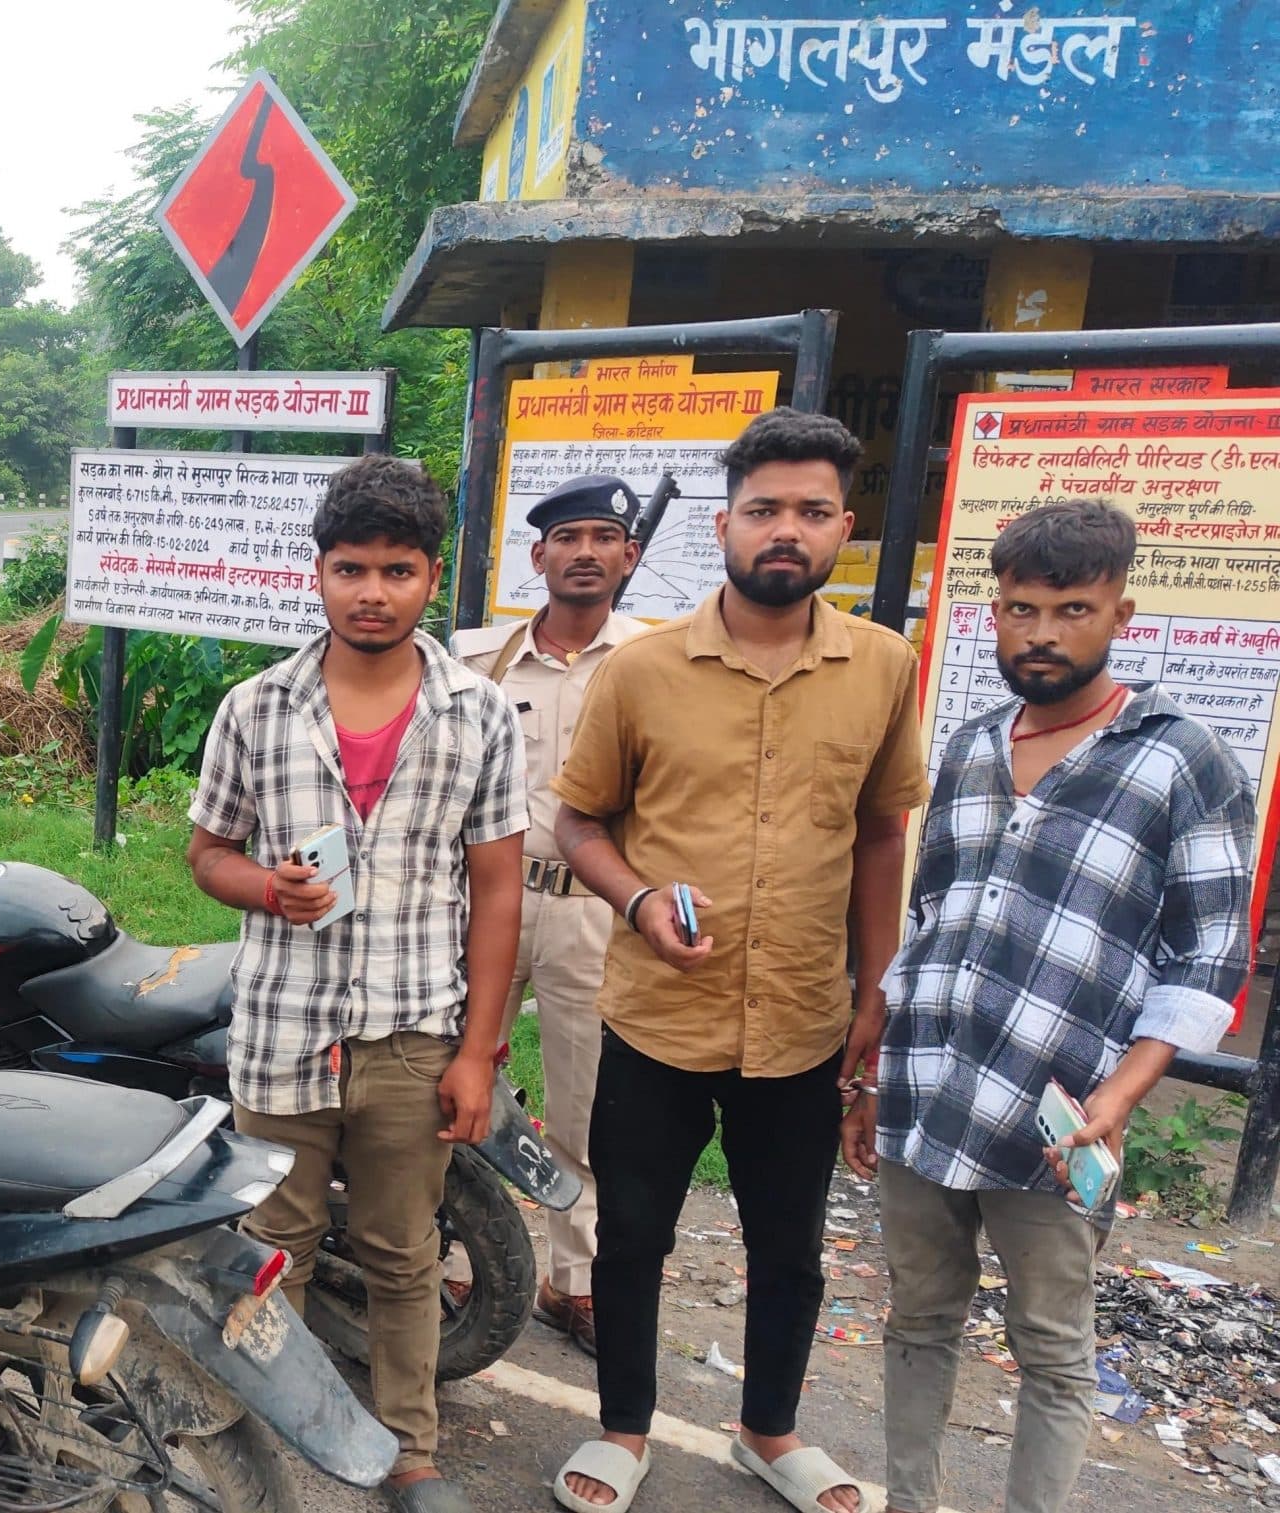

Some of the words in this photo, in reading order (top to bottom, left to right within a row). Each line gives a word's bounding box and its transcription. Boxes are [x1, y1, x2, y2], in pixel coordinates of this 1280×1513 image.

[684, 17, 947, 103] भागलपुर
[966, 0, 1136, 86] मंडल
[597, 365, 631, 381] भारत
[638, 359, 678, 380] निर्माण
[1090, 376, 1144, 396] भारत
[1150, 376, 1213, 396] सरकार
[116, 379, 192, 410] प्रधानमंत्री
[196, 388, 232, 413] ग्राम
[235, 389, 279, 419] सड़क
[516, 384, 591, 419] प्रधानमंत्री
[593, 393, 628, 417] ग्राम
[632, 392, 674, 422] सड़क
[1008, 411, 1089, 435] प्रधानमंत्री
[1097, 417, 1136, 434] ग्राम
[1143, 416, 1188, 437] सड़क
[973, 444, 1035, 469] डिफेक्ट
[1037, 443, 1132, 470] लायबिलिटी
[1135, 444, 1208, 471] पीरियड
[80, 462, 106, 480] सड़क
[107, 463, 121, 477] का
[177, 461, 189, 481] से
[236, 462, 269, 485] मिल्क
[271, 470, 298, 486] भाया
[78, 486, 94, 502] कुल
[1039, 472, 1055, 494] में
[1061, 471, 1138, 495] पंचवर्षीय
[1143, 480, 1222, 500] अनुरक्षण
[959, 499, 998, 513] अनुरक्षण
[1000, 497, 1026, 513] प्रारंभ
[1136, 502, 1185, 518] अनुरक्षण
[1188, 500, 1210, 520] पूर्ण
[1209, 500, 1224, 516] की
[109, 510, 121, 522] तक
[123, 512, 154, 528] अनुरक्षण
[156, 508, 165, 526] की
[76, 527, 93, 543] कार्य
[119, 528, 129, 546] की
[229, 538, 249, 555] कार्य
[253, 540, 269, 562] पूर्ण
[270, 539, 283, 559] की
[952, 547, 986, 564] सड़क
[1151, 548, 1187, 570] मिल्क
[1189, 555, 1221, 570] भाया
[146, 553, 176, 577] मेसर्स
[178, 557, 226, 583] रामसखी
[947, 566, 965, 581] कुल
[73, 576, 109, 593] कार्यकारी
[279, 597, 300, 614] कार्य
[74, 596, 102, 611] ग्रामीण
[105, 598, 135, 616] विकास
[138, 602, 174, 620] मंत्रालय
[178, 610, 202, 624] भारत
[206, 613, 241, 625] सरकार
[243, 617, 266, 632] द्वारा
[269, 616, 291, 635] वित्त
[952, 606, 978, 623] कुल
[1173, 628, 1198, 646] एक
[1199, 624, 1222, 647] वर्ष
[1224, 626, 1240, 647] में
[950, 671, 959, 685] 2
[1205, 660, 1216, 675] के
[945, 698, 954, 711] 3
[1183, 692, 1248, 710] आवश्यकता
[1249, 695, 1264, 712] हो
[940, 723, 950, 736] 4
[1246, 724, 1260, 742] हो
